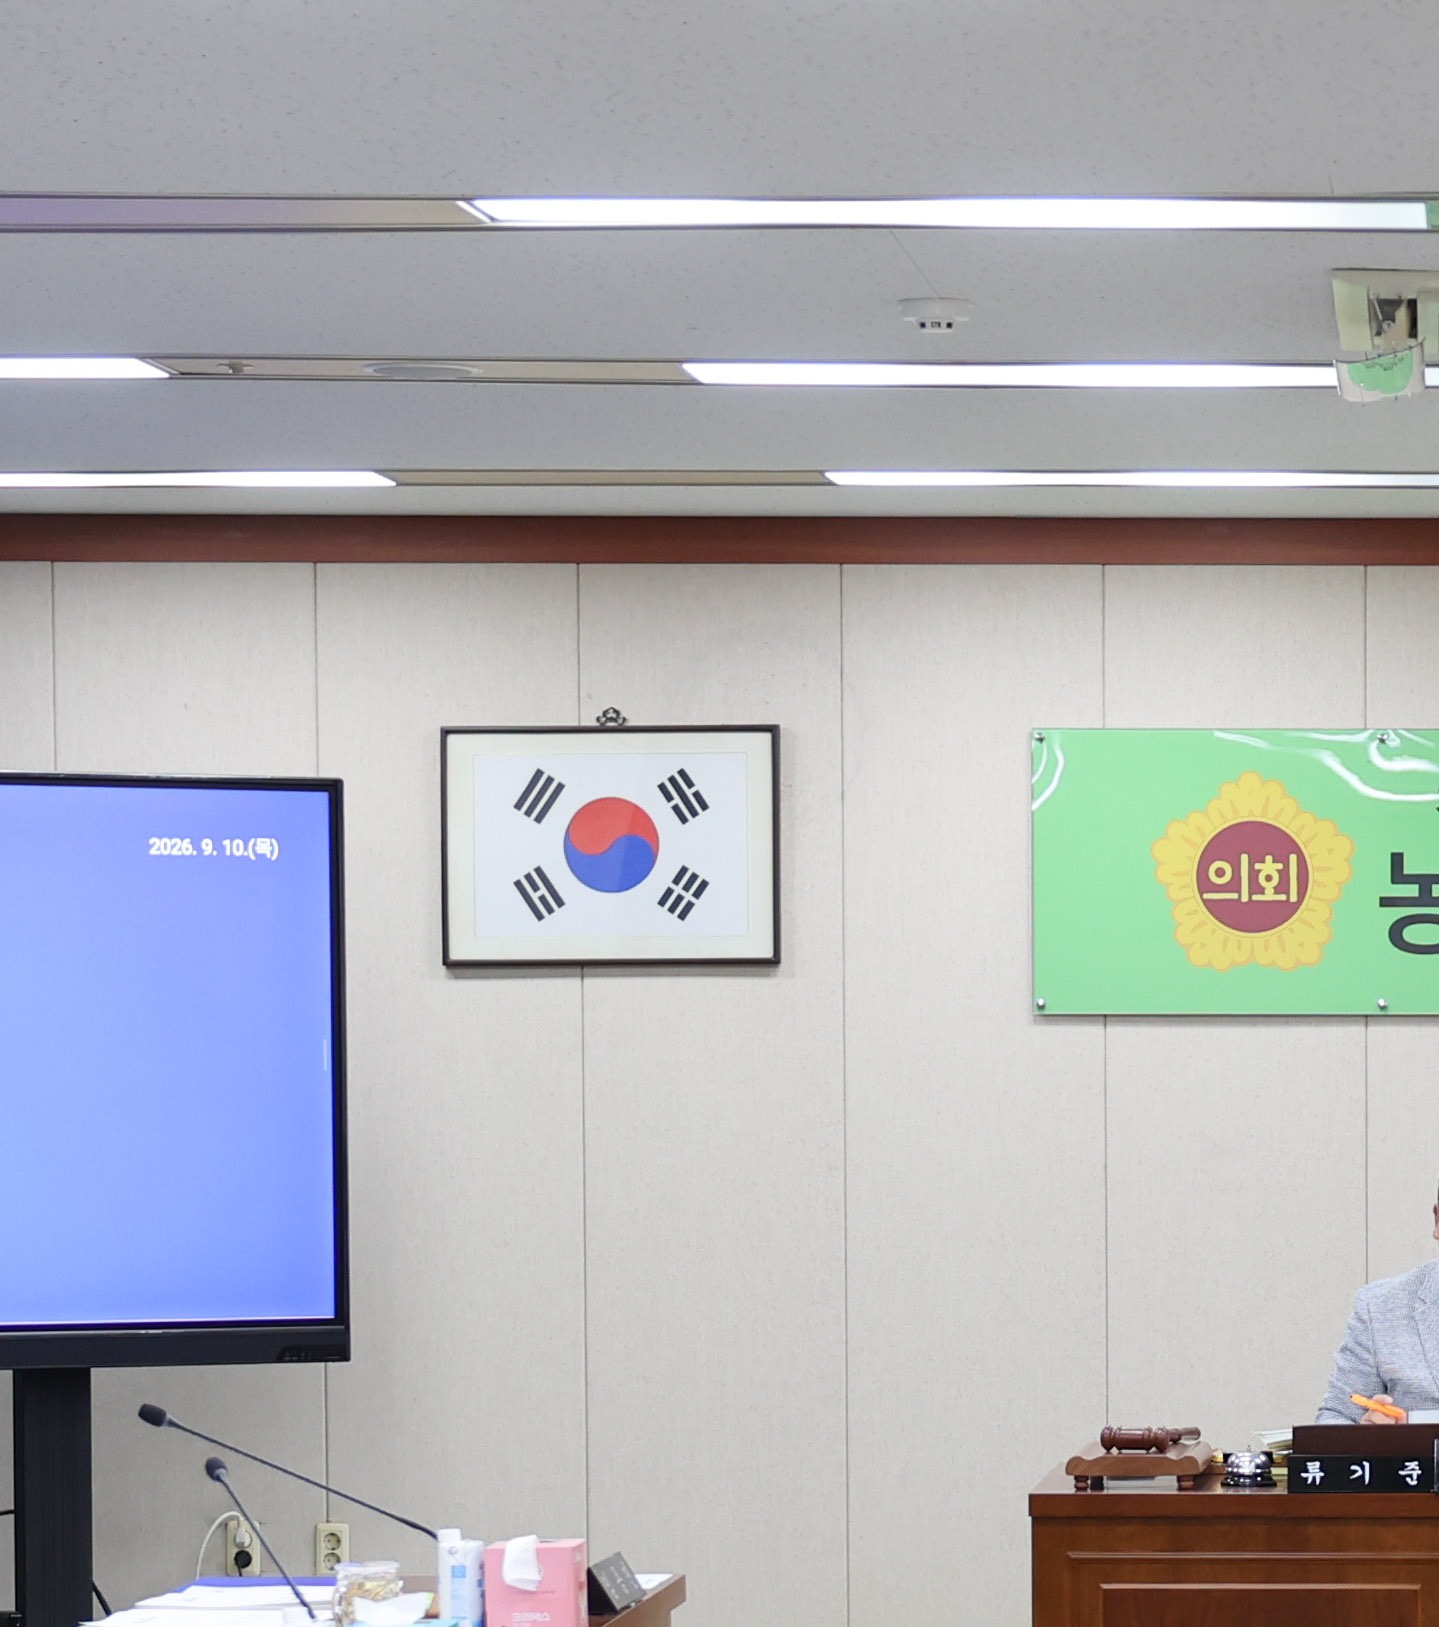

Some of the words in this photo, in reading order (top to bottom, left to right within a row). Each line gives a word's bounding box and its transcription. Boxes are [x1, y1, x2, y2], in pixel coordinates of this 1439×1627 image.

[148, 837, 197, 856] 2026.
[200, 838, 218, 856] 9.
[222, 837, 279, 861] 10.(목)
[1201, 856, 1299, 905] 의회
